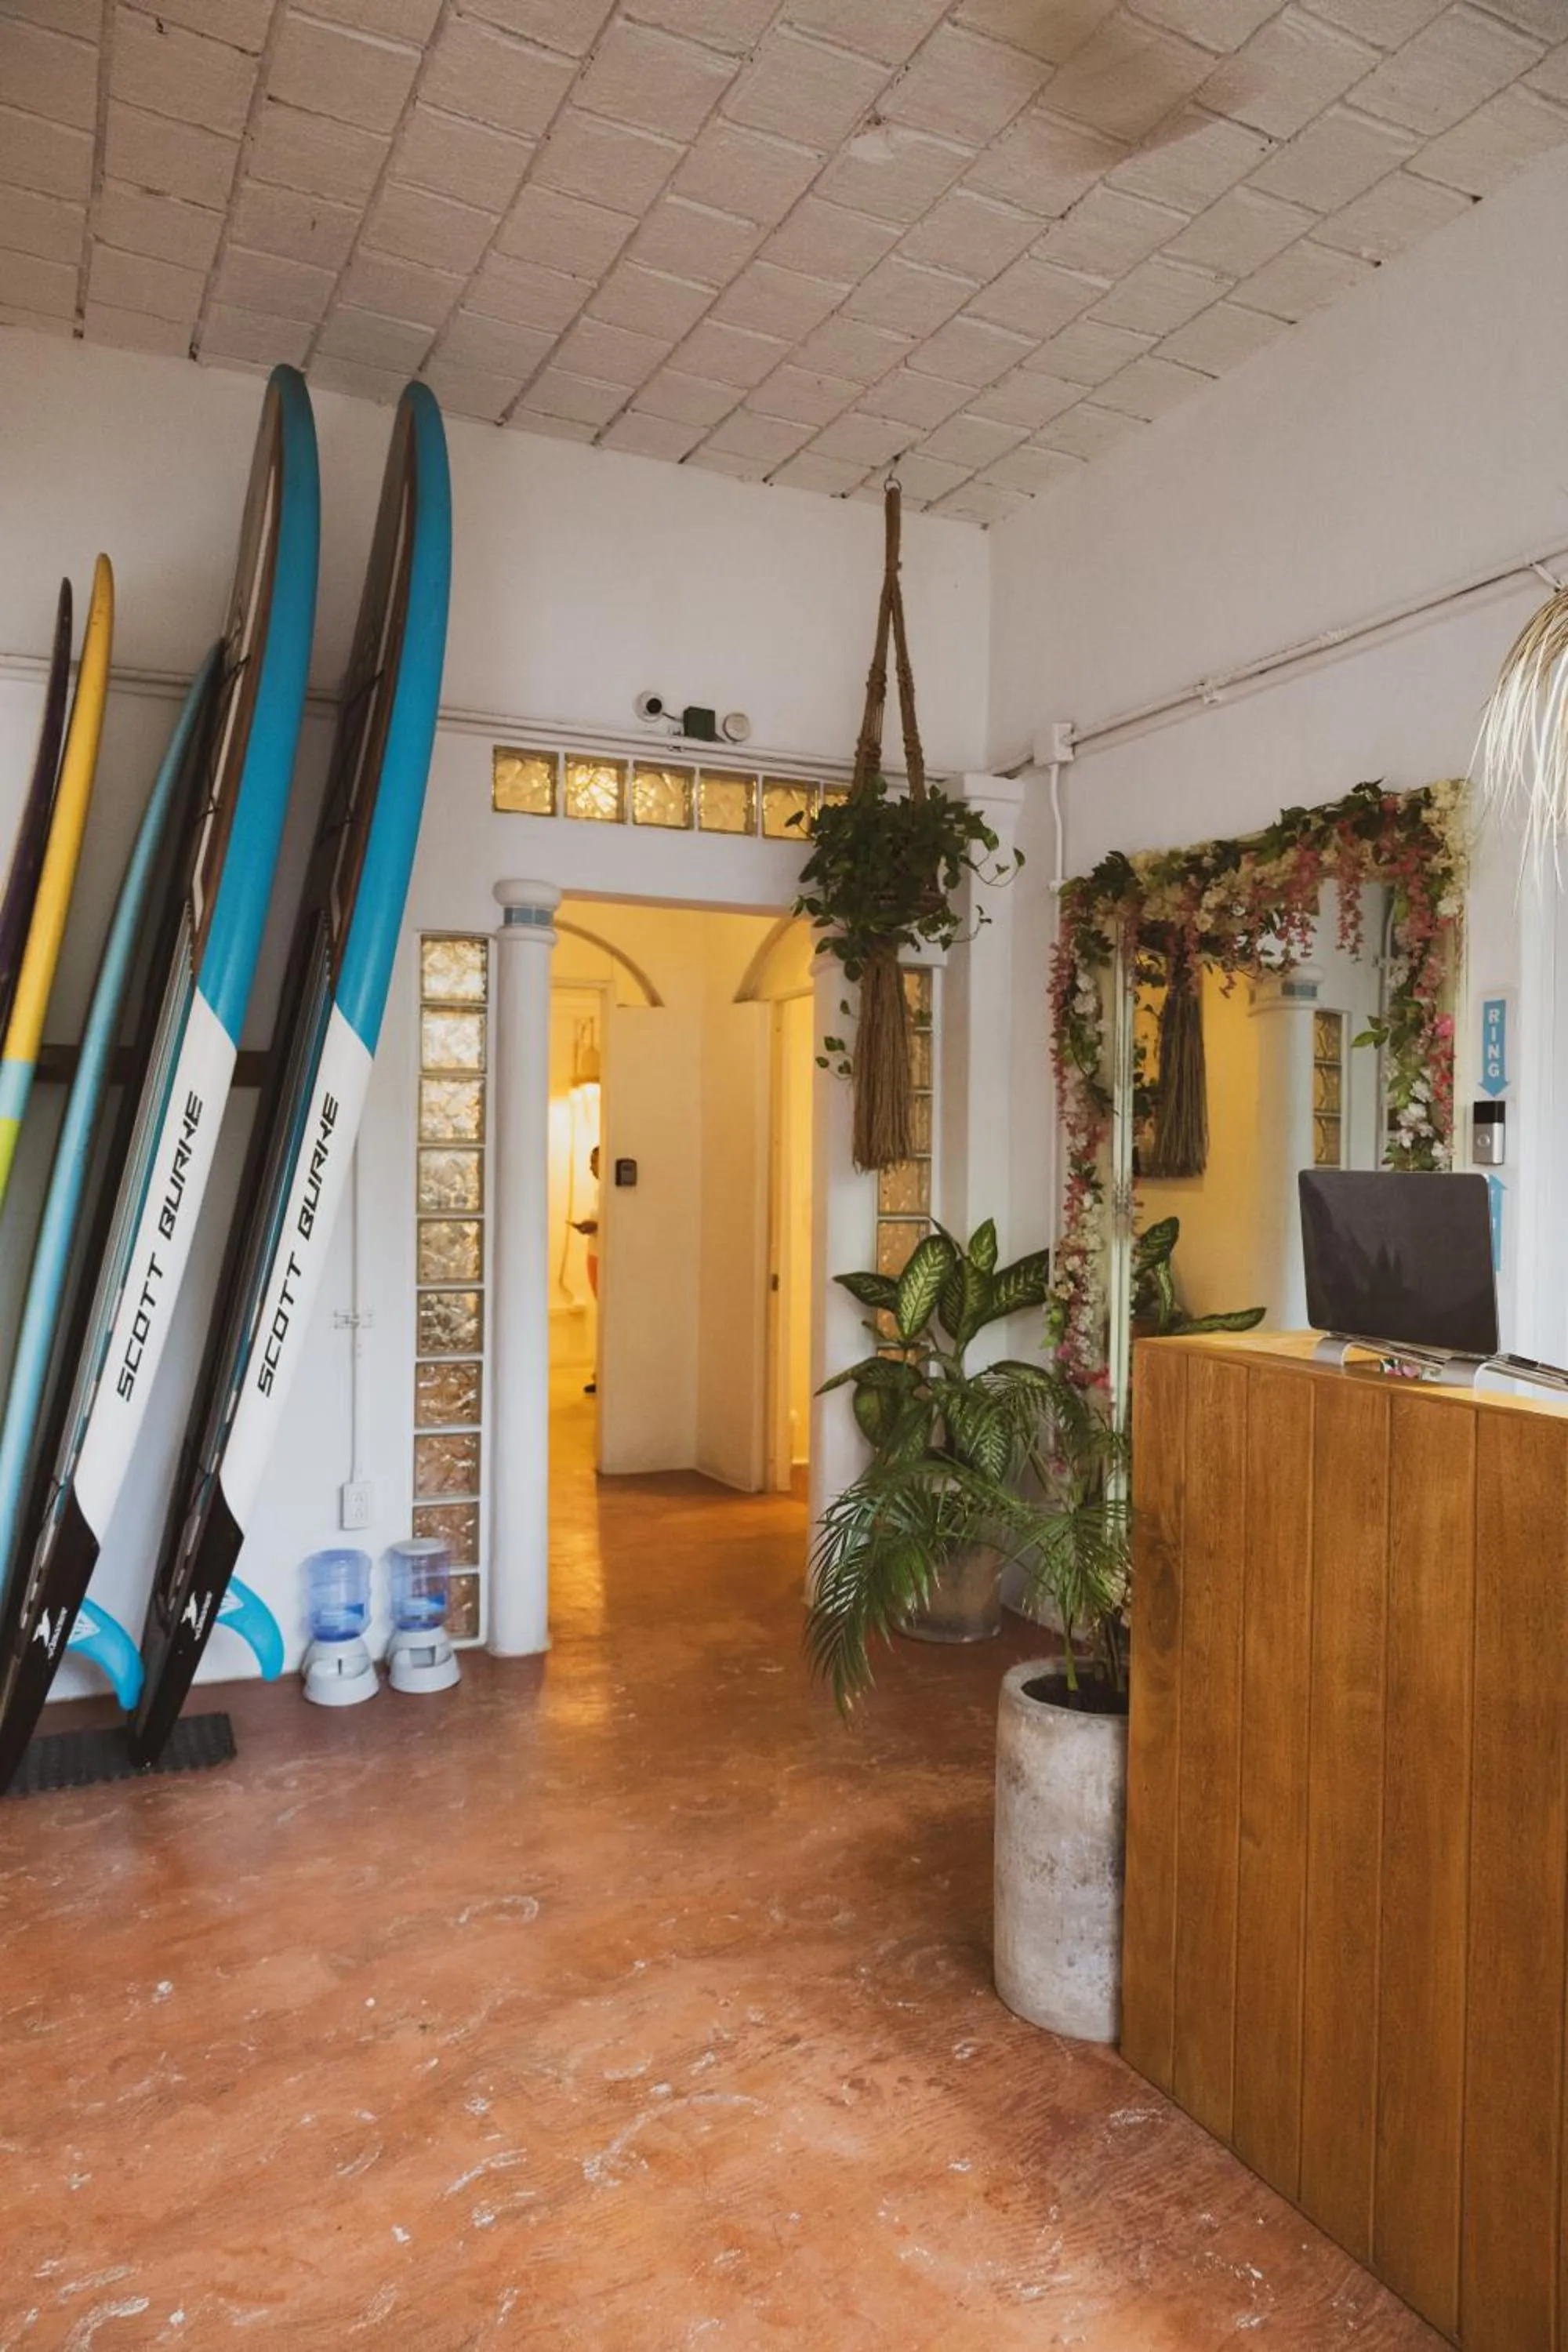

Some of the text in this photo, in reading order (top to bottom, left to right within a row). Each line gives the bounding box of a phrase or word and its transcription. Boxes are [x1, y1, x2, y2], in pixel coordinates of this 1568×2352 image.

[1488, 1007, 1501, 1078] RING
[117, 1091, 203, 1402] SCOTT BURKE
[257, 1092, 339, 1397] SCOTT BURKE
